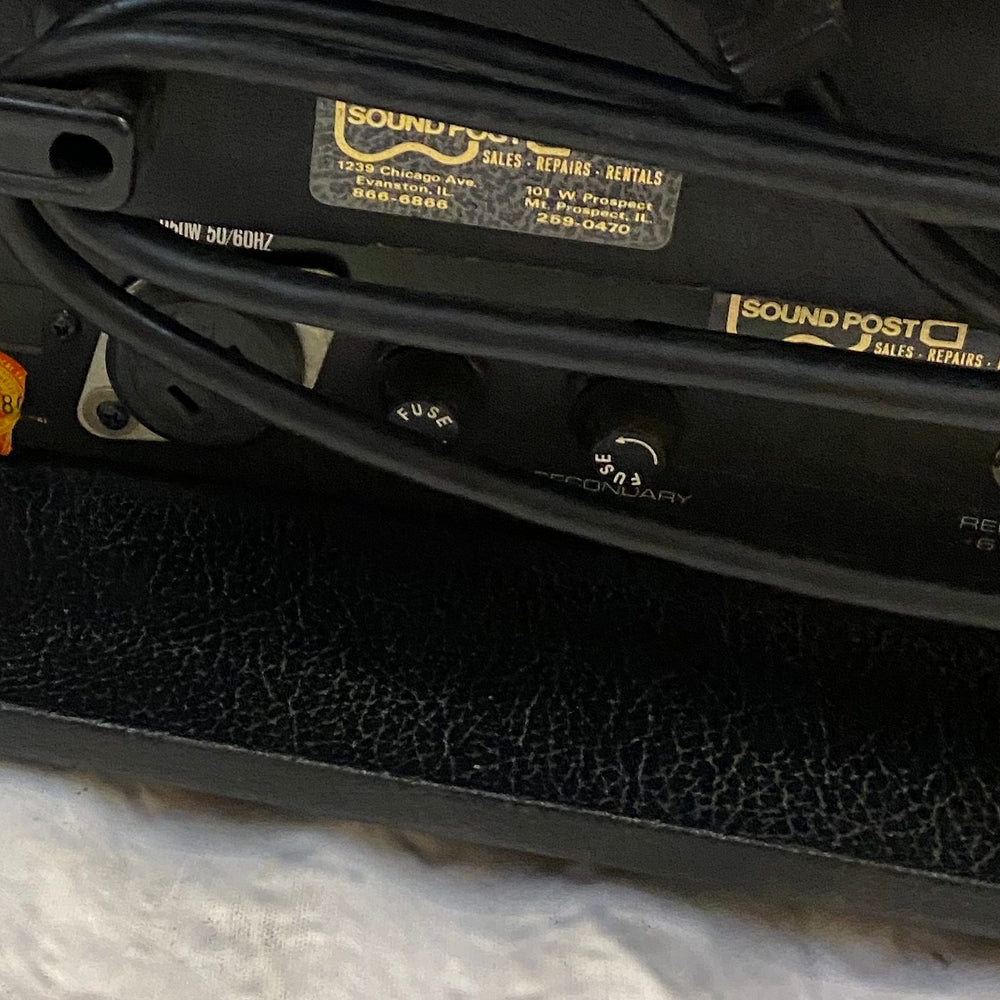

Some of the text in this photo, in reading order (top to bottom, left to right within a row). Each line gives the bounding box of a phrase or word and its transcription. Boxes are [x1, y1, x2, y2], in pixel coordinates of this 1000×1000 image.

[347, 105, 445, 135] SOUND
[338, 160, 477, 188] 1239 Chicago Ave.
[482, 150, 663, 187] SALES REPAIRS RENTALS
[525, 185, 550, 197] 101
[582, 192, 653, 212] Prospect
[206, 225, 274, 252] 50/60HZ
[741, 299, 921, 338] SOUND POST
[874, 341, 984, 369] SALES REPAIRS
[396, 403, 453, 428] FUSE
[595, 453, 641, 487] FUSE
